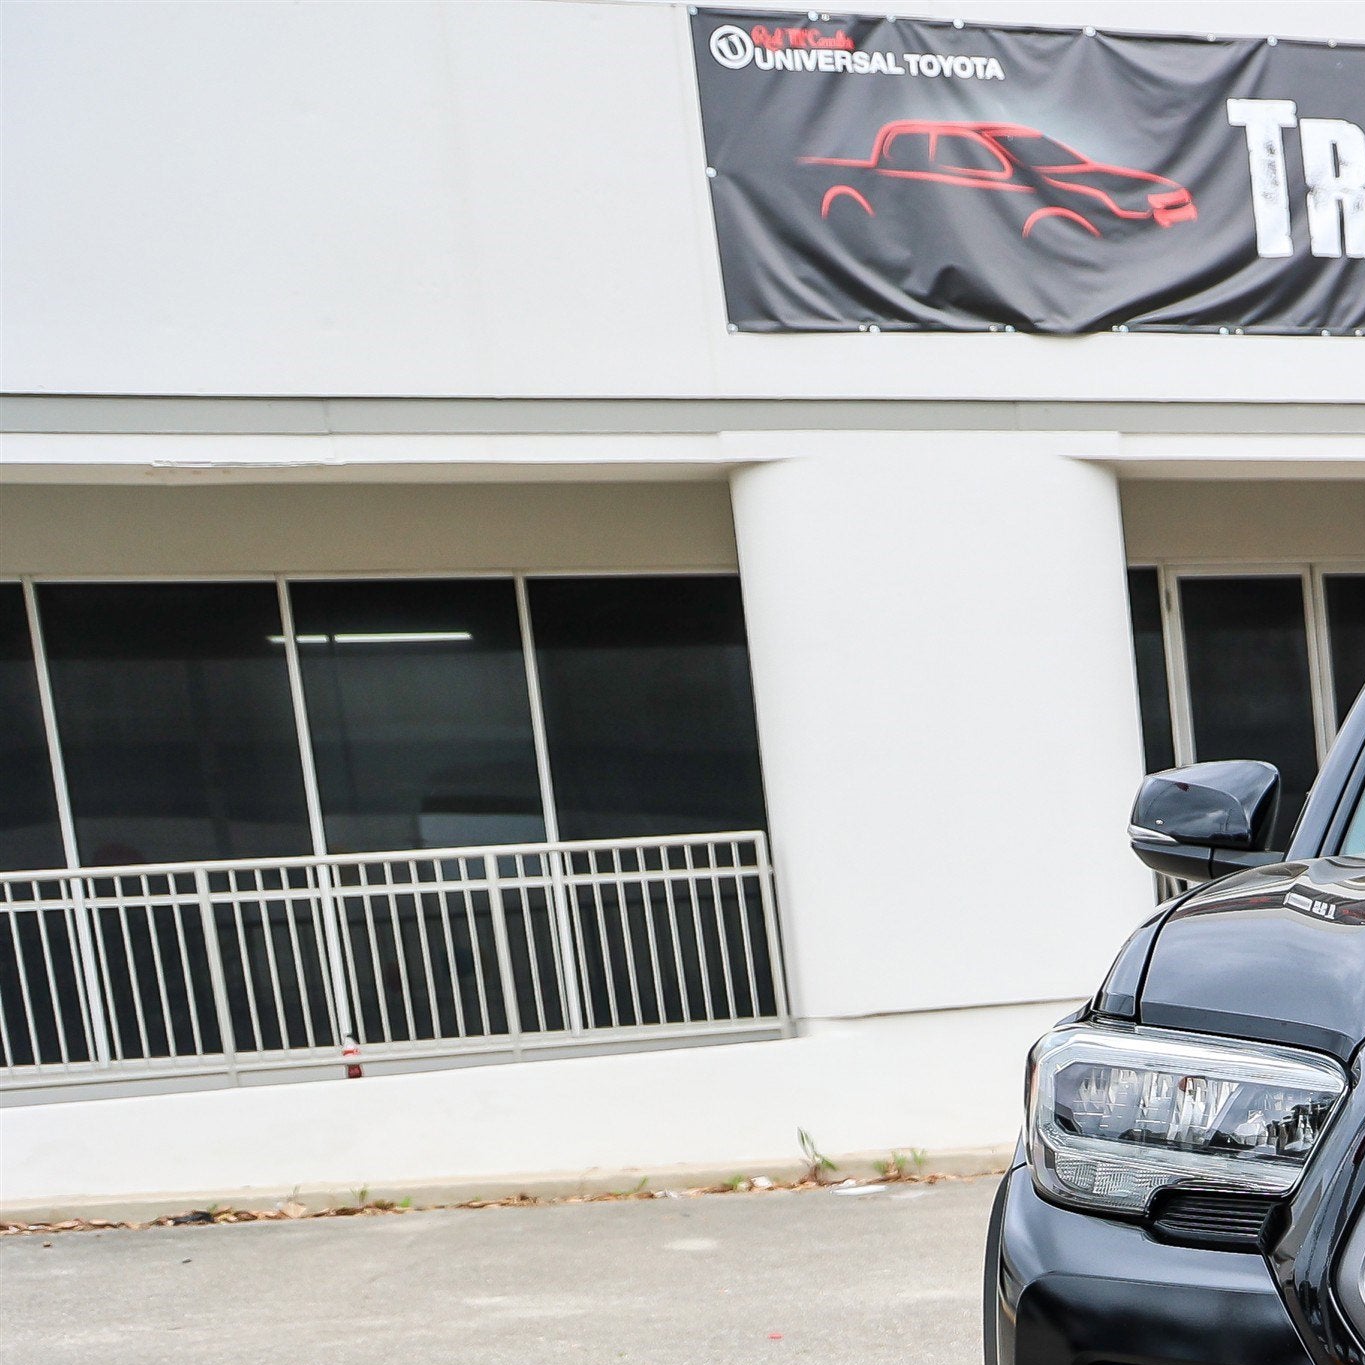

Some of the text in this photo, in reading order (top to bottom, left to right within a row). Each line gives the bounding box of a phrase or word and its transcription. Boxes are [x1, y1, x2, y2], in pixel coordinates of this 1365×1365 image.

[752, 25, 783, 49] Red
[754, 46, 1006, 81] UNIVERSAL TOYOTA
